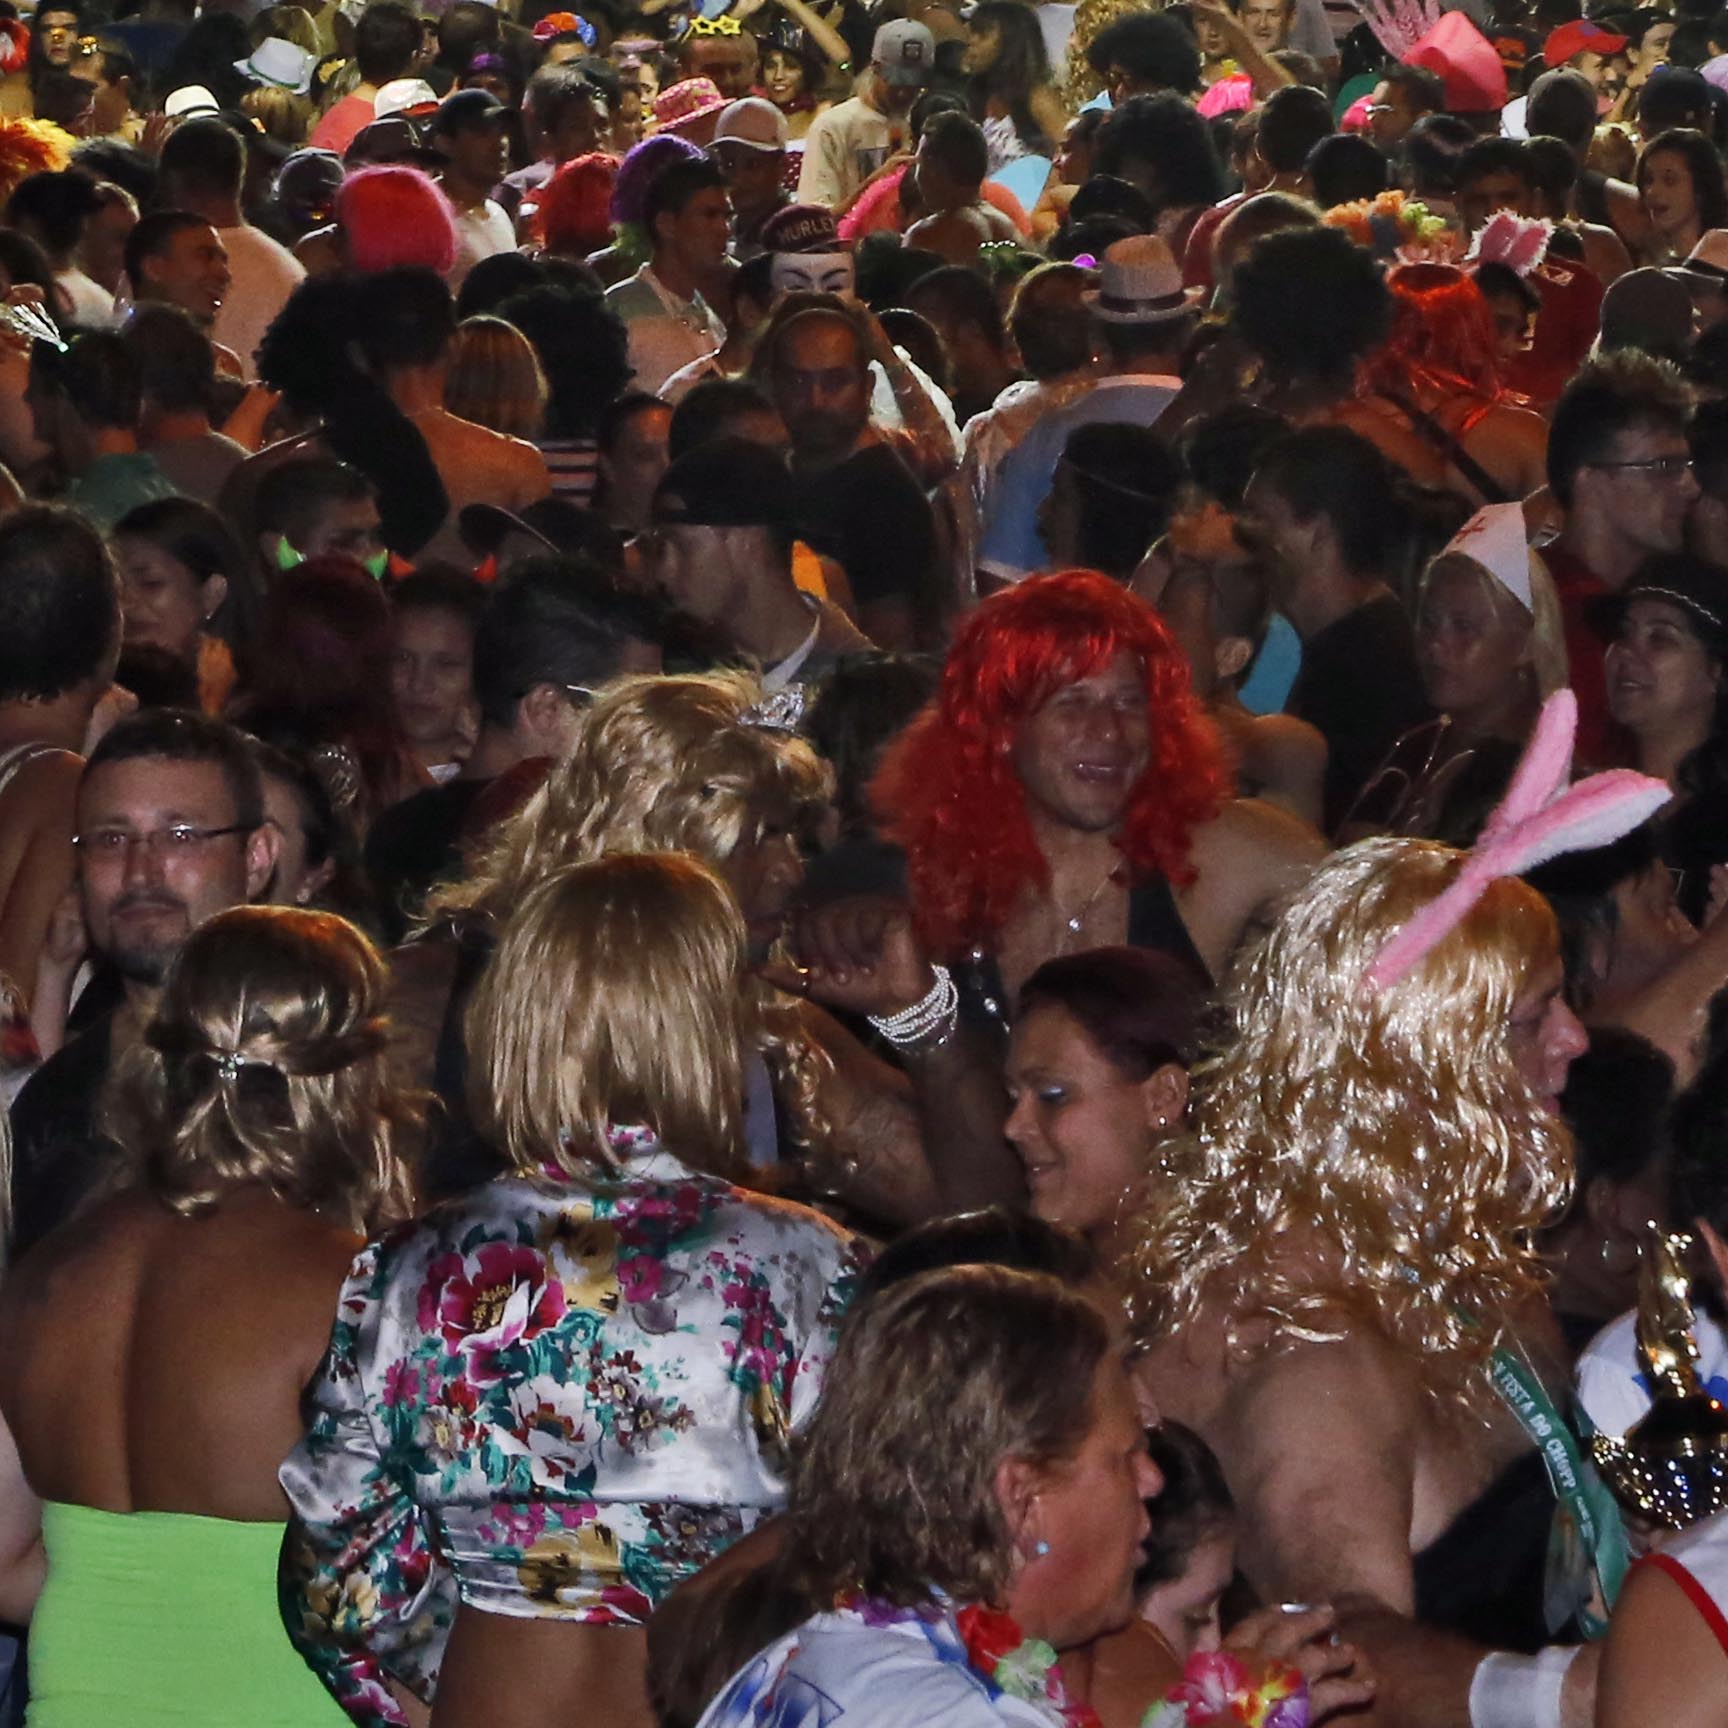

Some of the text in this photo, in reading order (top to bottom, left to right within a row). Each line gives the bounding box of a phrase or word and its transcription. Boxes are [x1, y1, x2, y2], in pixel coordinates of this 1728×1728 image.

[1500, 1372, 1577, 1489] FESTA DO CHOPP
